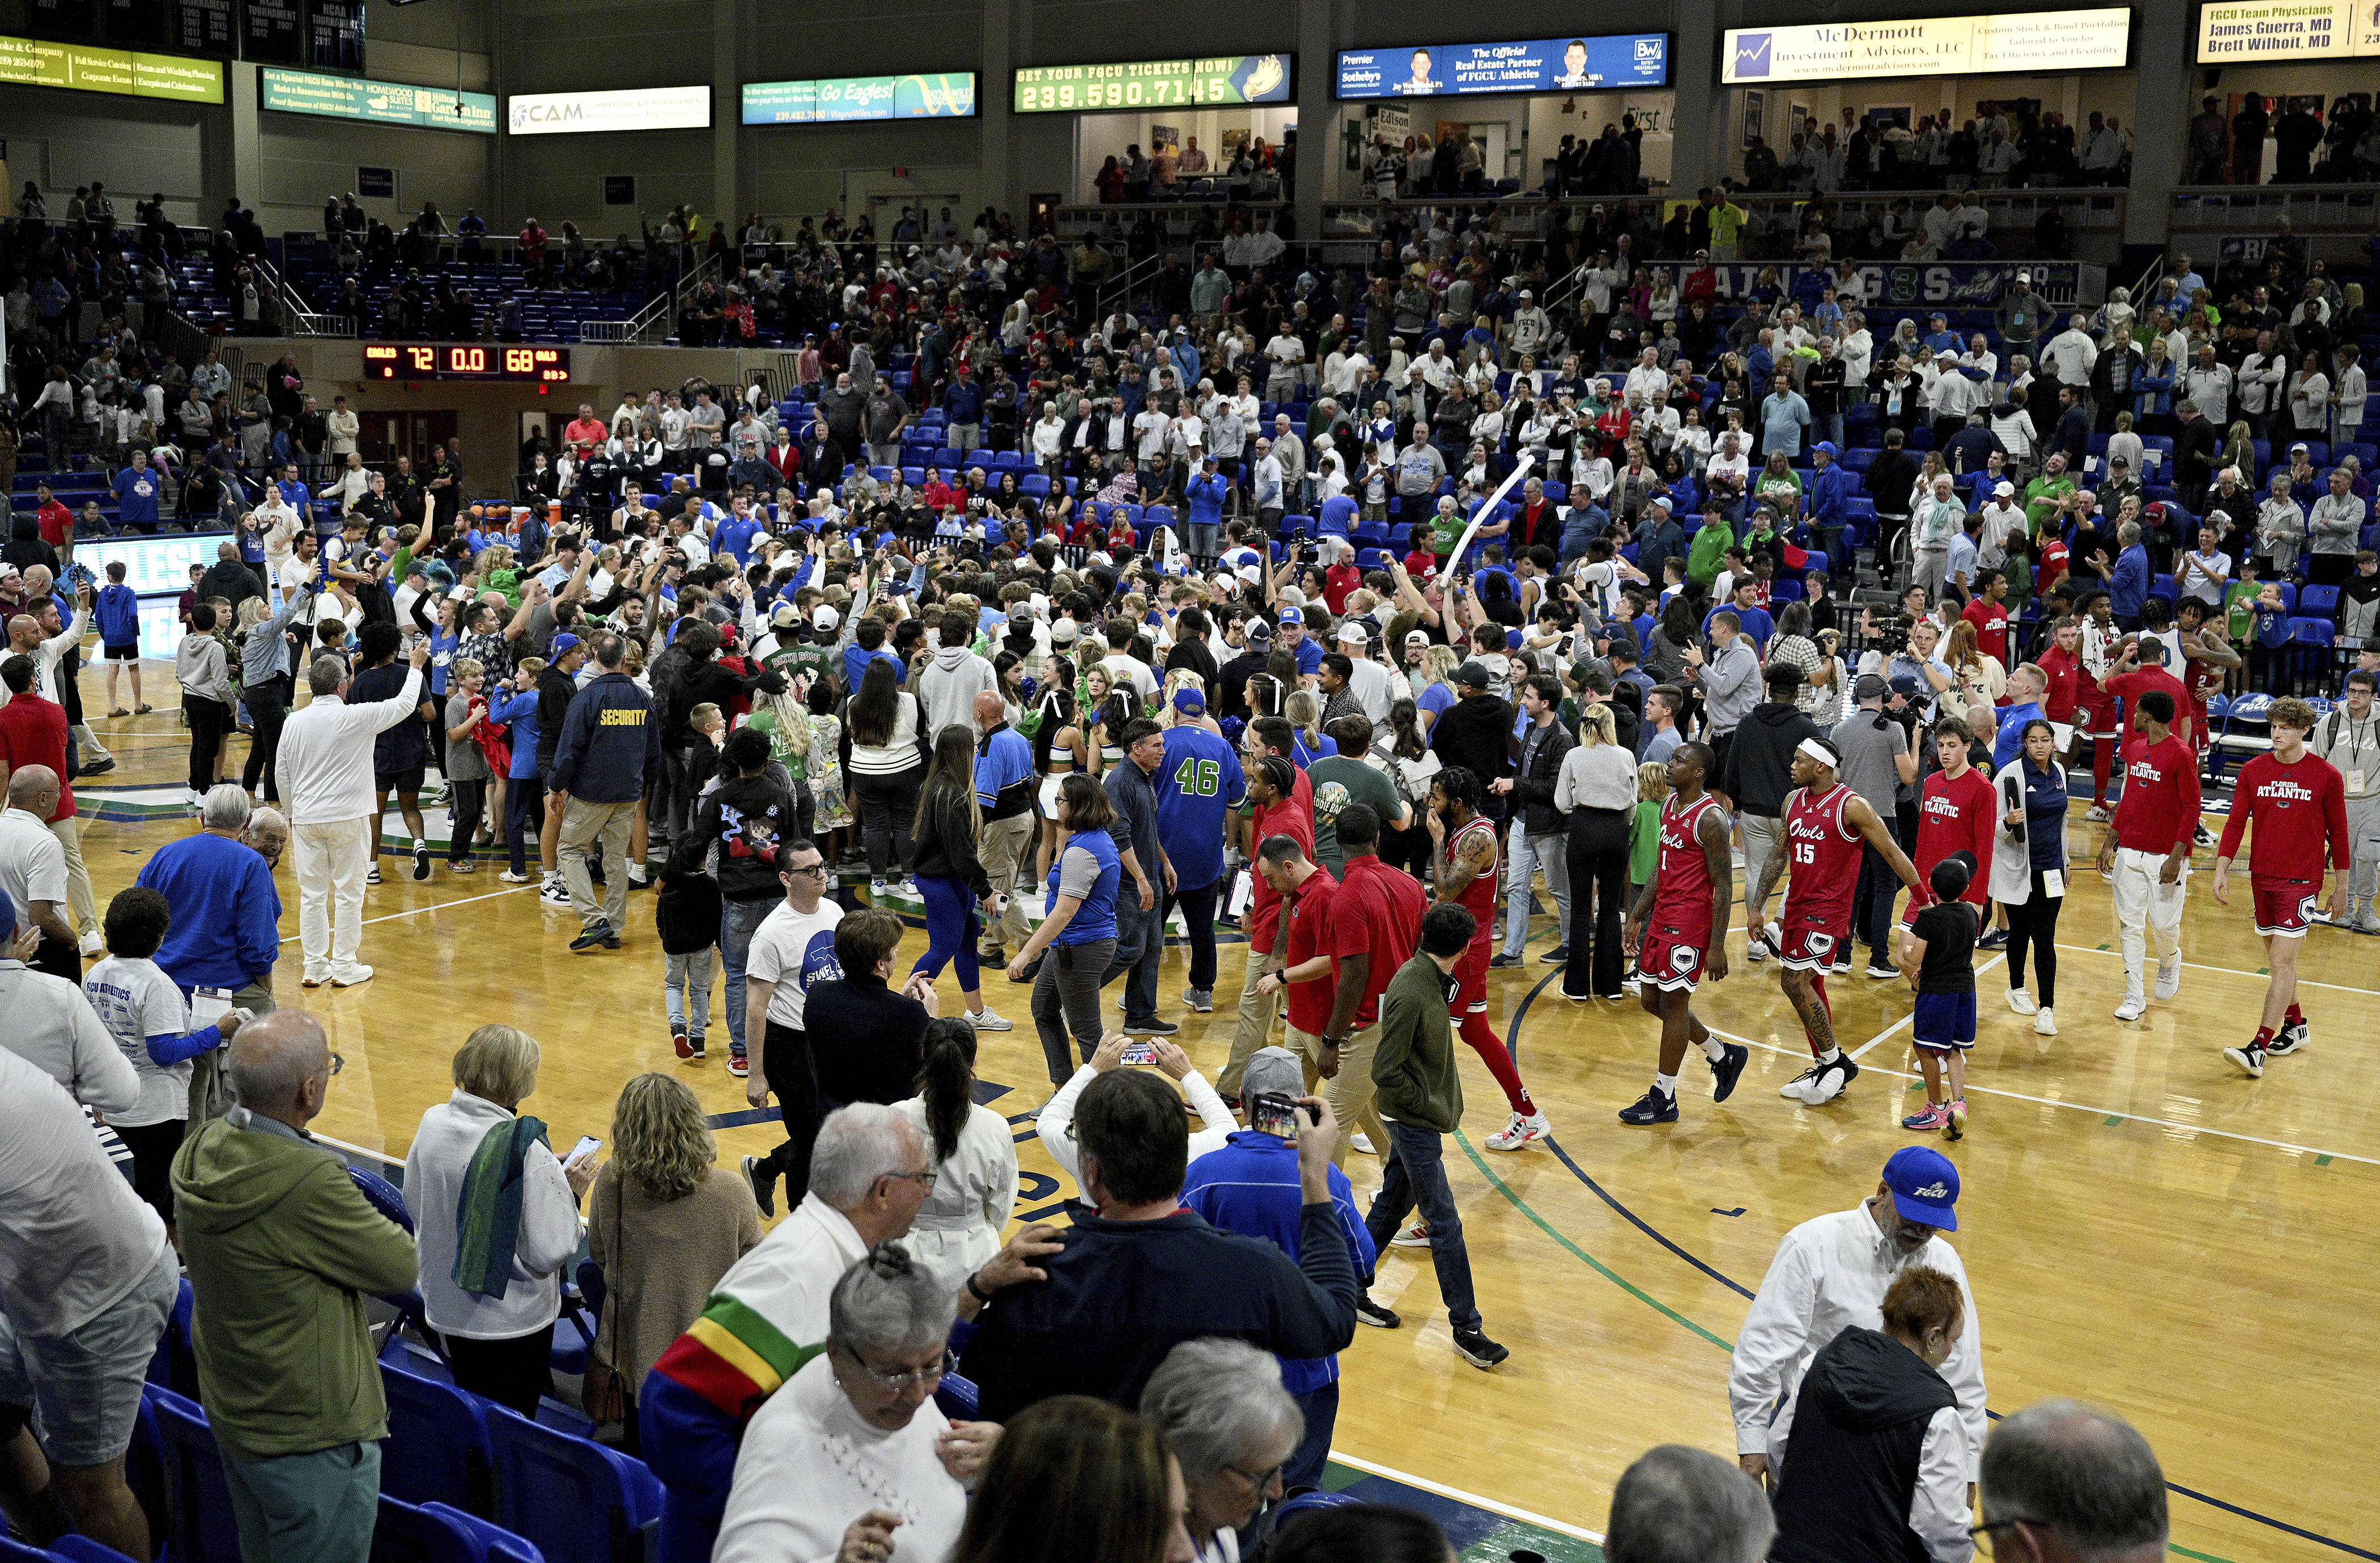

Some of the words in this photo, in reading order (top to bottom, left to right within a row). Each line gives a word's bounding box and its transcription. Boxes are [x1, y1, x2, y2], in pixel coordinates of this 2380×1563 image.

[248, 5, 296, 21] TOURNAMENT
[323, 4, 346, 18] NCAA
[2210, 10, 2237, 21] FGCU
[2241, 8, 2269, 19] Team
[2272, 5, 2334, 18] Physicians
[1814, 24, 1926, 44] McDermott
[1978, 26, 2012, 35] Custom
[2016, 24, 2041, 33] Stock
[2081, 20, 2128, 29] Portfolios
[2209, 24, 2253, 37] James
[2256, 21, 2306, 34] Guerra,
[2310, 18, 2332, 31] MD
[2009, 37, 2045, 46] Tailored
[2208, 40, 2244, 52] Brett
[2247, 36, 2304, 51] Wilhoit,
[2308, 35, 2331, 48] MD
[26, 44, 65, 57] Company
[1472, 48, 1490, 58] The
[1491, 45, 1527, 59] Official
[1637, 41, 1658, 58] BW
[1776, 49, 1854, 62] Investment
[1863, 45, 1930, 57] Advisors,
[1936, 42, 1964, 54] LLC
[2002, 49, 2046, 59] Efficiency
[2071, 46, 2119, 56] Flexibility
[75, 56, 86, 65] Full
[87, 57, 108, 67] Service
[108, 60, 132, 71] Catering
[1342, 54, 1374, 65] Premier
[1455, 61, 1475, 71] Real
[1477, 59, 1506, 70] Estate
[1507, 57, 1543, 69] Partner
[166, 66, 192, 78] Wedding
[1017, 69, 1043, 83] GET
[1047, 66, 1083, 81] YOUR
[1088, 65, 1124, 79] FGCU
[1128, 61, 1189, 78] TICKETS
[1194, 60, 1232, 74] NOW!
[1794, 61, 1940, 74] www.mcdermottadvisors.com
[82, 71, 112, 82] Corporate
[112, 74, 132, 84] Events
[265, 71, 275, 79] Get
[281, 73, 304, 83] Special
[304, 75, 321, 85] FGCU
[321, 78, 335, 87] Rate
[335, 79, 352, 89] When
[352, 82, 363, 91] You
[1341, 71, 1381, 83] Sotheby's
[1456, 71, 1468, 82] of
[1468, 70, 1498, 82] FGCU
[1499, 69, 1540, 80] Athletics
[138, 77, 170, 88] Exceptional
[171, 80, 205, 92] Celebrations
[274, 83, 291, 93] Make
[296, 86, 330, 97] Reservation
[332, 90, 346, 99] With
[367, 84, 413, 97] HOMEWOOD
[432, 92, 457, 104] Hilton
[821, 84, 842, 101] Go
[845, 80, 896, 106] Eagles!
[951, 87, 975, 97] WILES
[1022, 78, 1225, 110] 239.590.7145
[287, 99, 312, 108] Sponsors
[389, 95, 413, 106] SUITES
[586, 101, 634, 109] COMMERCIAL
[652, 97, 706, 107] MANAGEMENT
[759, 97, 772, 107] your
[471, 106, 491, 119] Inn
[529, 103, 583, 122] CAM
[831, 109, 888, 121] WayneWiles.com
[1381, 110, 1409, 128] Edison
[445, 116, 460, 124] Myers
[301, 235, 315, 245] NN
[1518, 319, 1535, 328] FGCU
[1523, 327, 1529, 337] 2
[367, 347, 396, 358] EAGLES
[407, 347, 433, 370] 72
[452, 347, 484, 371] 0.0
[507, 350, 533, 372] 68
[536, 350, 557, 362] OWLS
[771, 652, 798, 668] BETTY
[798, 651, 821, 664] BOOP
[2198, 674, 2207, 687] 2
[601, 709, 647, 726] SECURITY
[2336, 730, 2377, 751] Owls
[1174, 757, 1220, 797] 46
[2256, 785, 2313, 801] ATLANTIC
[1314, 798, 1331, 812] EDDIE
[1930, 796, 1950, 805] FLORIDA
[1789, 818, 1826, 841] Owls
[1795, 842, 1816, 864] 15
[1661, 850, 1668, 871] 1
[806, 963, 835, 983] SWFL
[1912, 1186, 1948, 1199] FGCU
